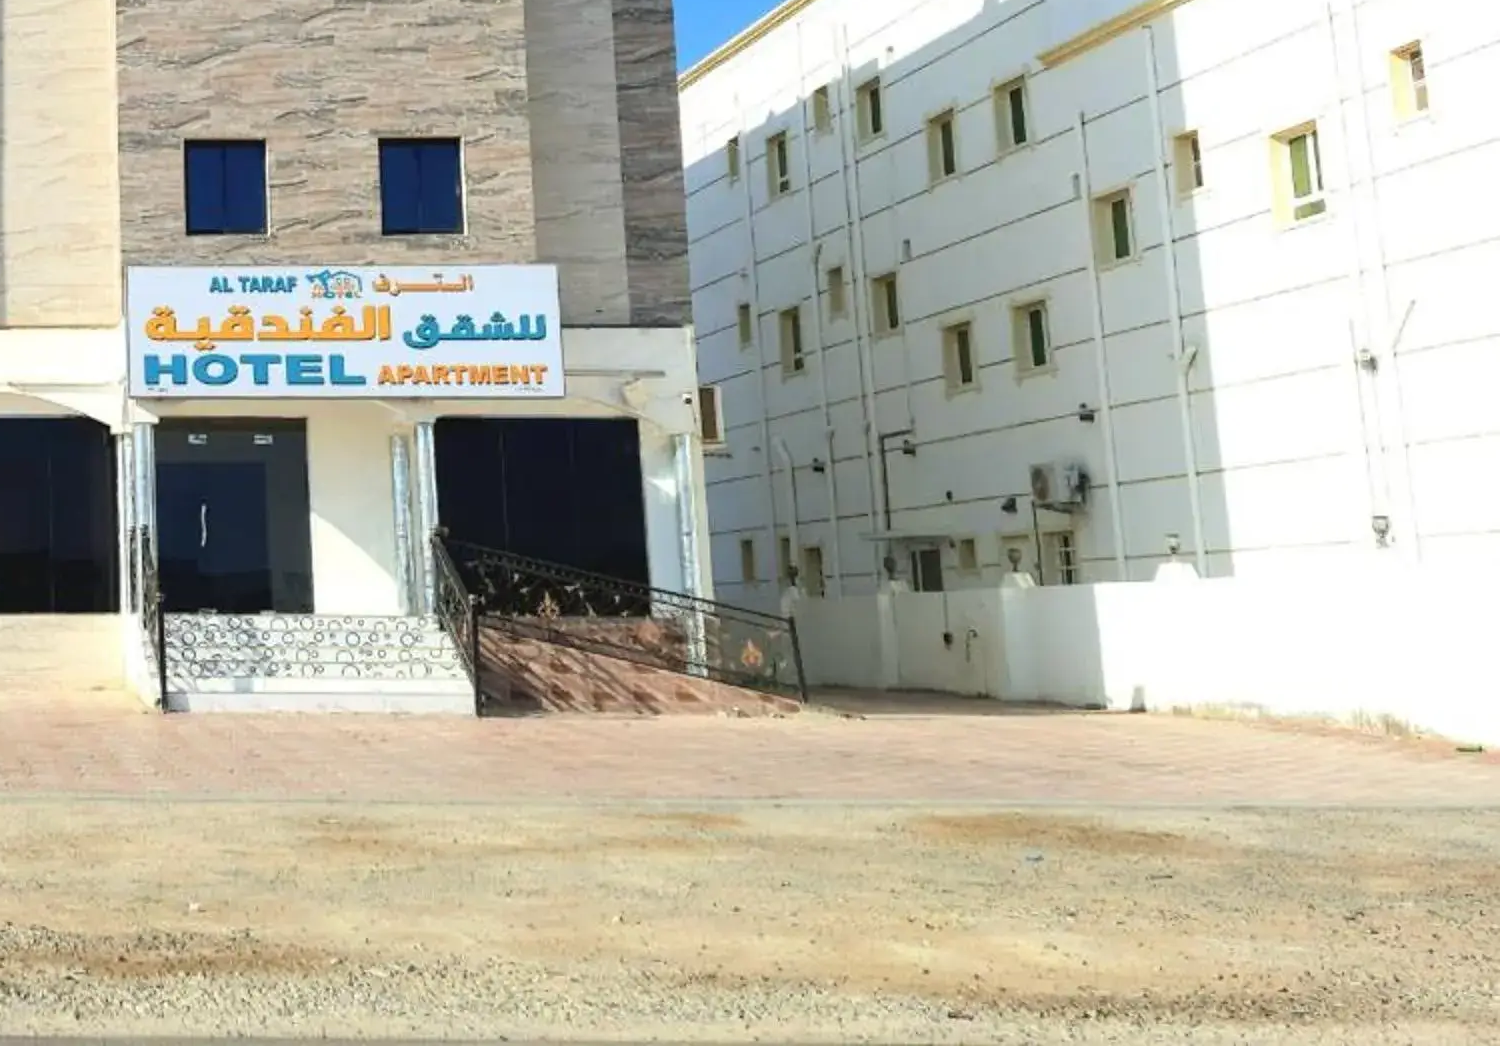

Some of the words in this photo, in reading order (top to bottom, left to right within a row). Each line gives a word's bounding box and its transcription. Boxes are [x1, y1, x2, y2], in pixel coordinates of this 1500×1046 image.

[209, 276, 234, 293] AL
[238, 275, 298, 293] TARAF
[145, 305, 392, 351] الفندقية
[403, 311, 547, 349] للشقق
[144, 354, 367, 386] HOTEL
[378, 364, 548, 386] APARTMENT
